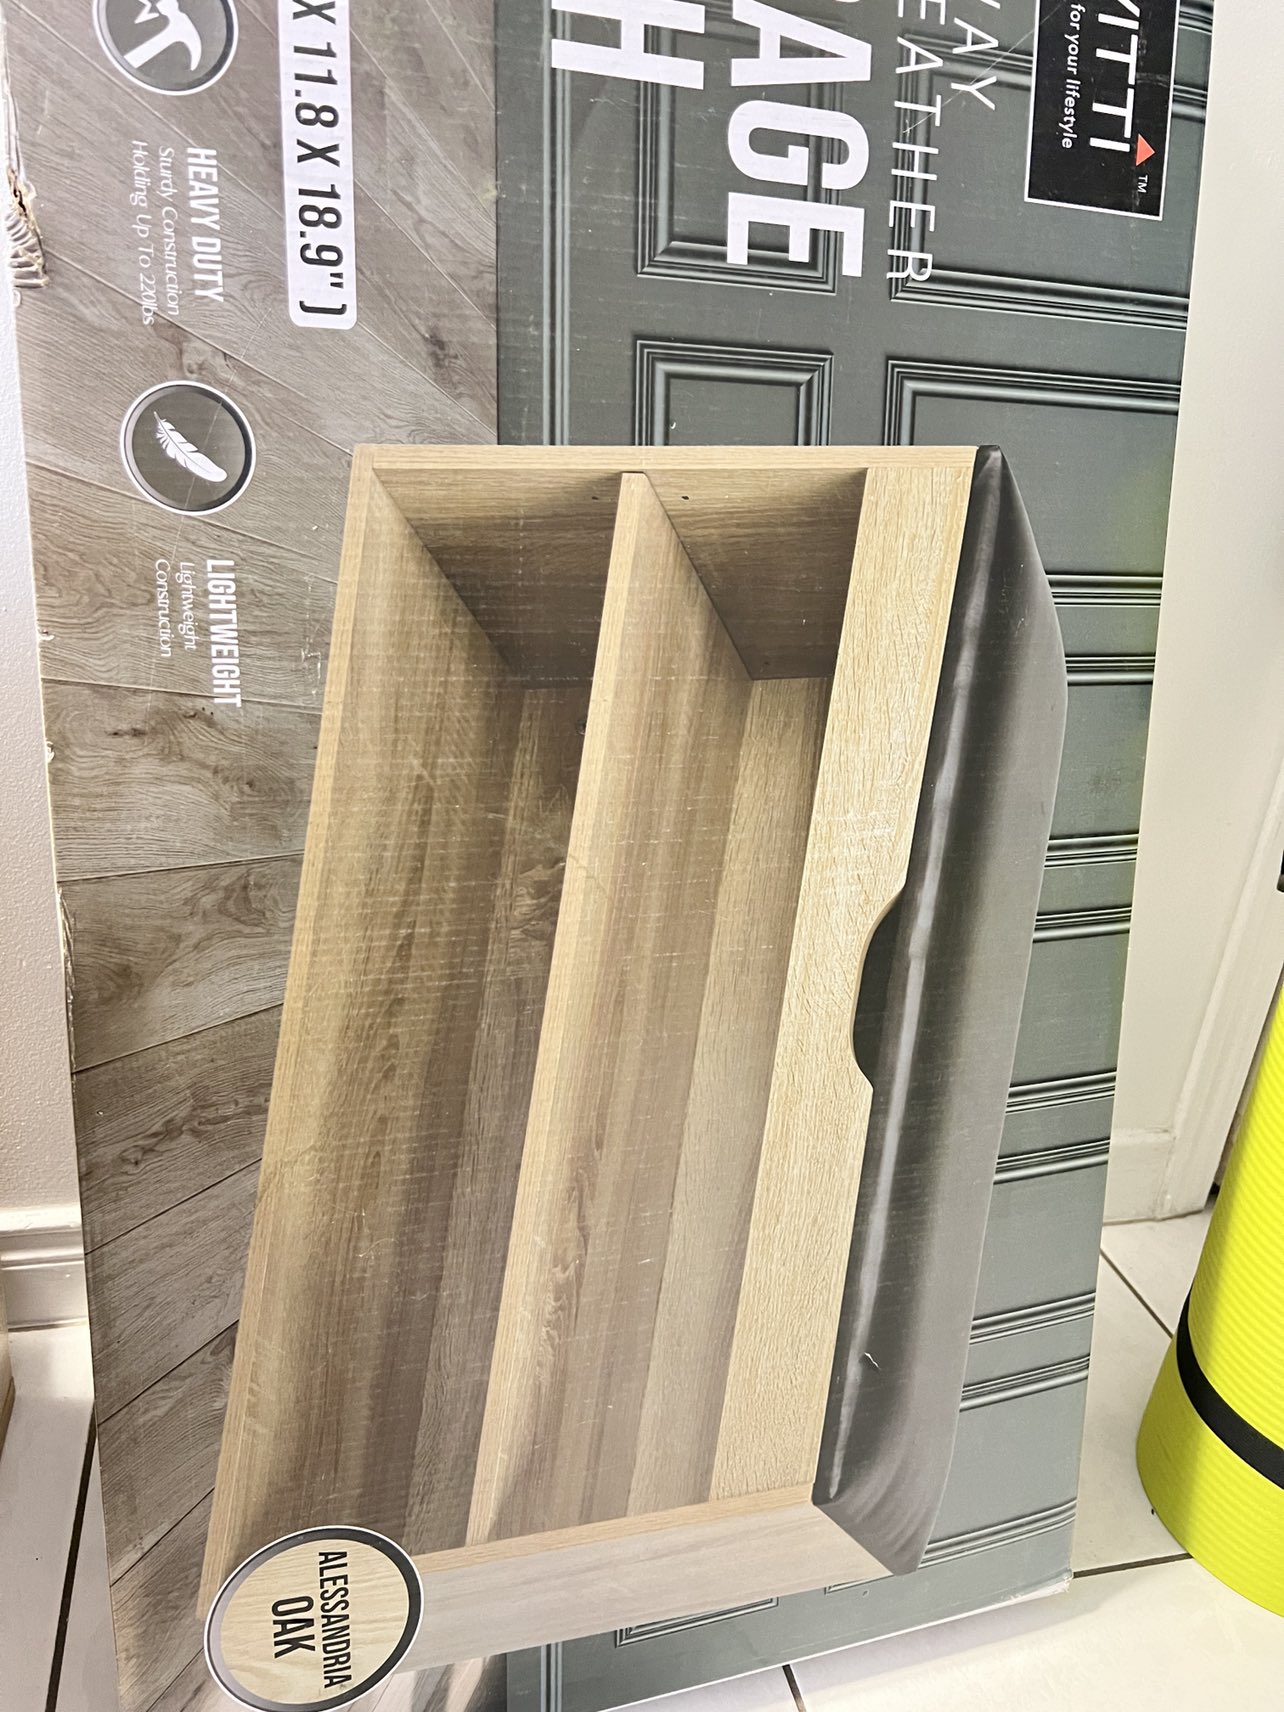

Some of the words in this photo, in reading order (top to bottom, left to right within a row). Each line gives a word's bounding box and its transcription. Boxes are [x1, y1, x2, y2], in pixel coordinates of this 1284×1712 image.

[292, 0, 337, 26] X
[1070, 3, 1087, 30] for
[293, 41, 340, 128] 11.8
[1063, 33, 1081, 76] your
[727, 0, 873, 277] AGE
[1058, 78, 1081, 149] lifestyle
[129, 140, 152, 209] Holding
[156, 145, 179, 203] Sturdy
[296, 138, 341, 167] X
[186, 147, 221, 231] HEAVY
[131, 214, 153, 238] Up
[137, 243, 155, 269] To
[297, 183, 345, 289] 18.9"
[161, 206, 184, 317] Construction
[191, 236, 225, 303] DUTY
[139, 272, 159, 327] 220lbs
[155, 558, 173, 658] Construction
[175, 561, 199, 651] Lightweight
[206, 559, 242, 708] LIGHTWEIGHT
[271, 1595, 316, 1659] OAK
[318, 1551, 352, 1689] ALESSANDRIA
